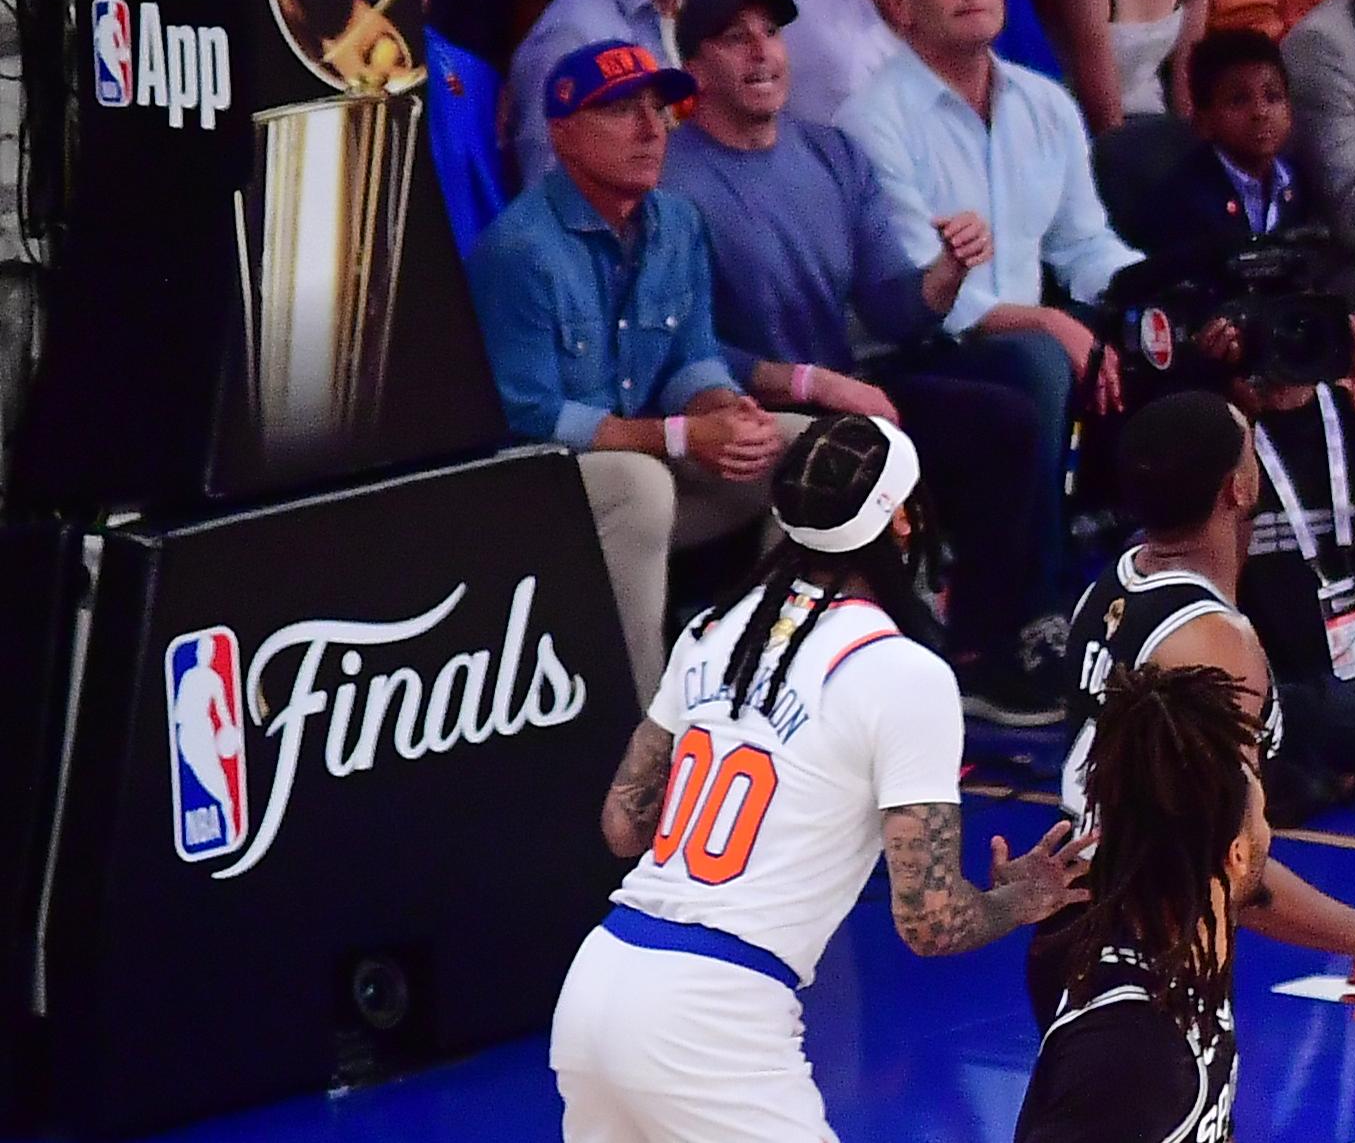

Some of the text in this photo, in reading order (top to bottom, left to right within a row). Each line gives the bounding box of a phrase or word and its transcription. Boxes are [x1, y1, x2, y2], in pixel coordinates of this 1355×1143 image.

[136, 2, 231, 130] App
[211, 575, 587, 880] Finals
[684, 661, 809, 745] CLKON
[1080, 641, 1114, 705] FO
[654, 725, 778, 885] 00
